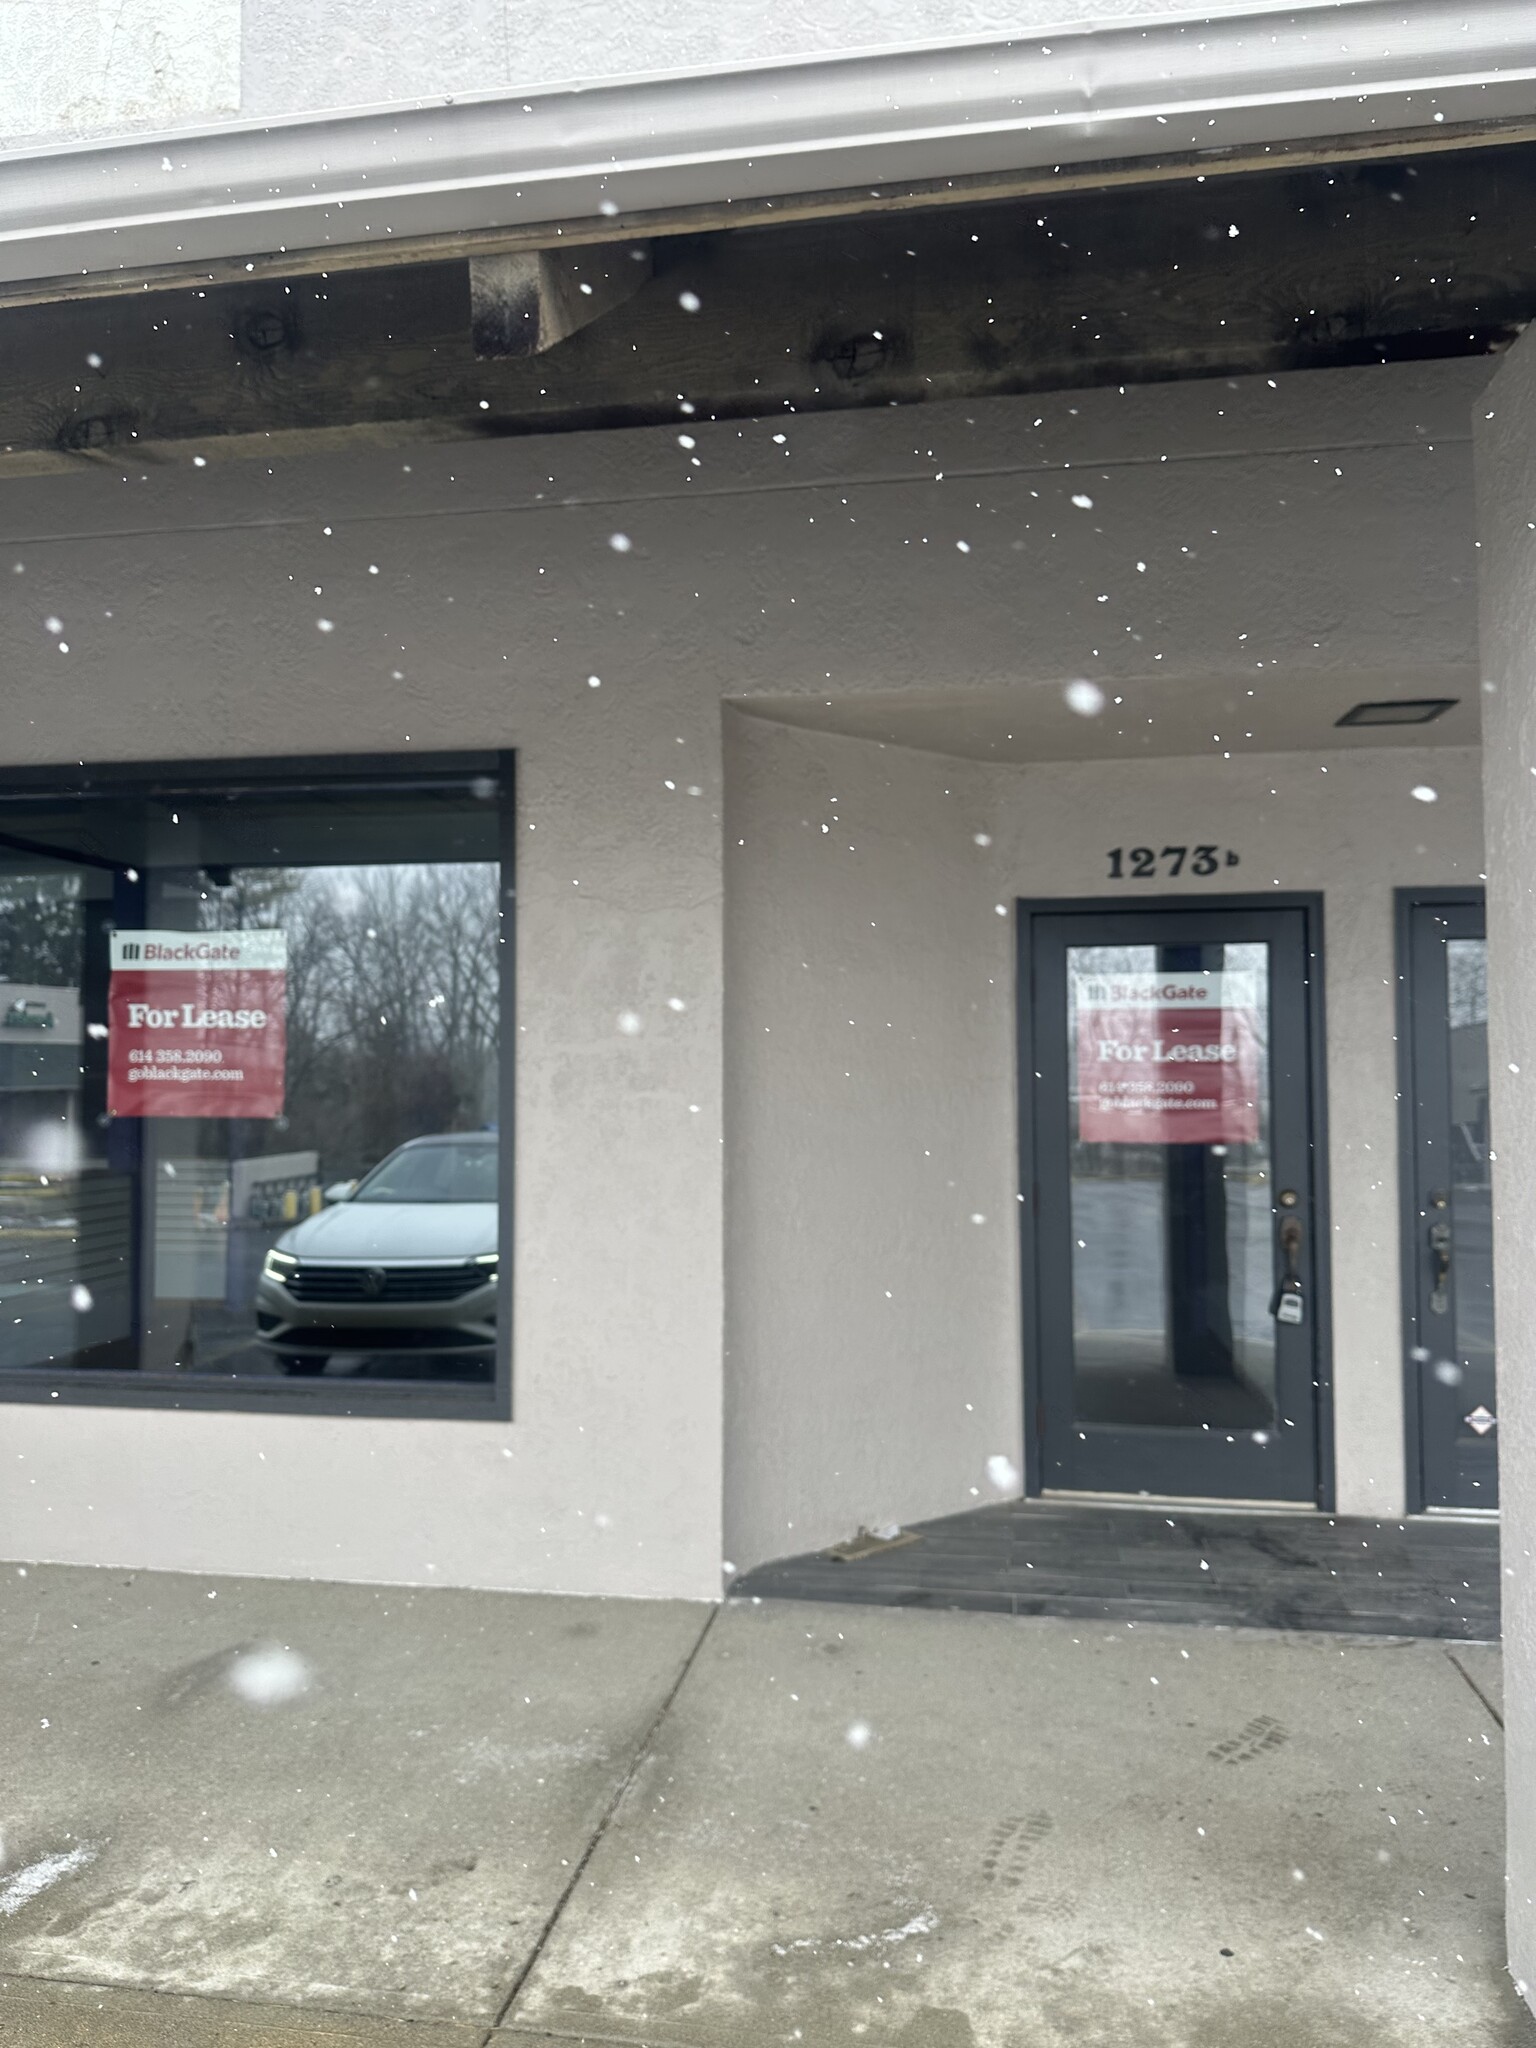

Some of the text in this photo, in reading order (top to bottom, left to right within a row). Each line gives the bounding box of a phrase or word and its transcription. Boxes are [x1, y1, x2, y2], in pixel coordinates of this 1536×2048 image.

[144, 942, 241, 961] BlackGate
[127, 1003, 267, 1030] For Lease
[1098, 1040, 1237, 1064] For Lease
[127, 1065, 244, 1083] goblackgate.com
